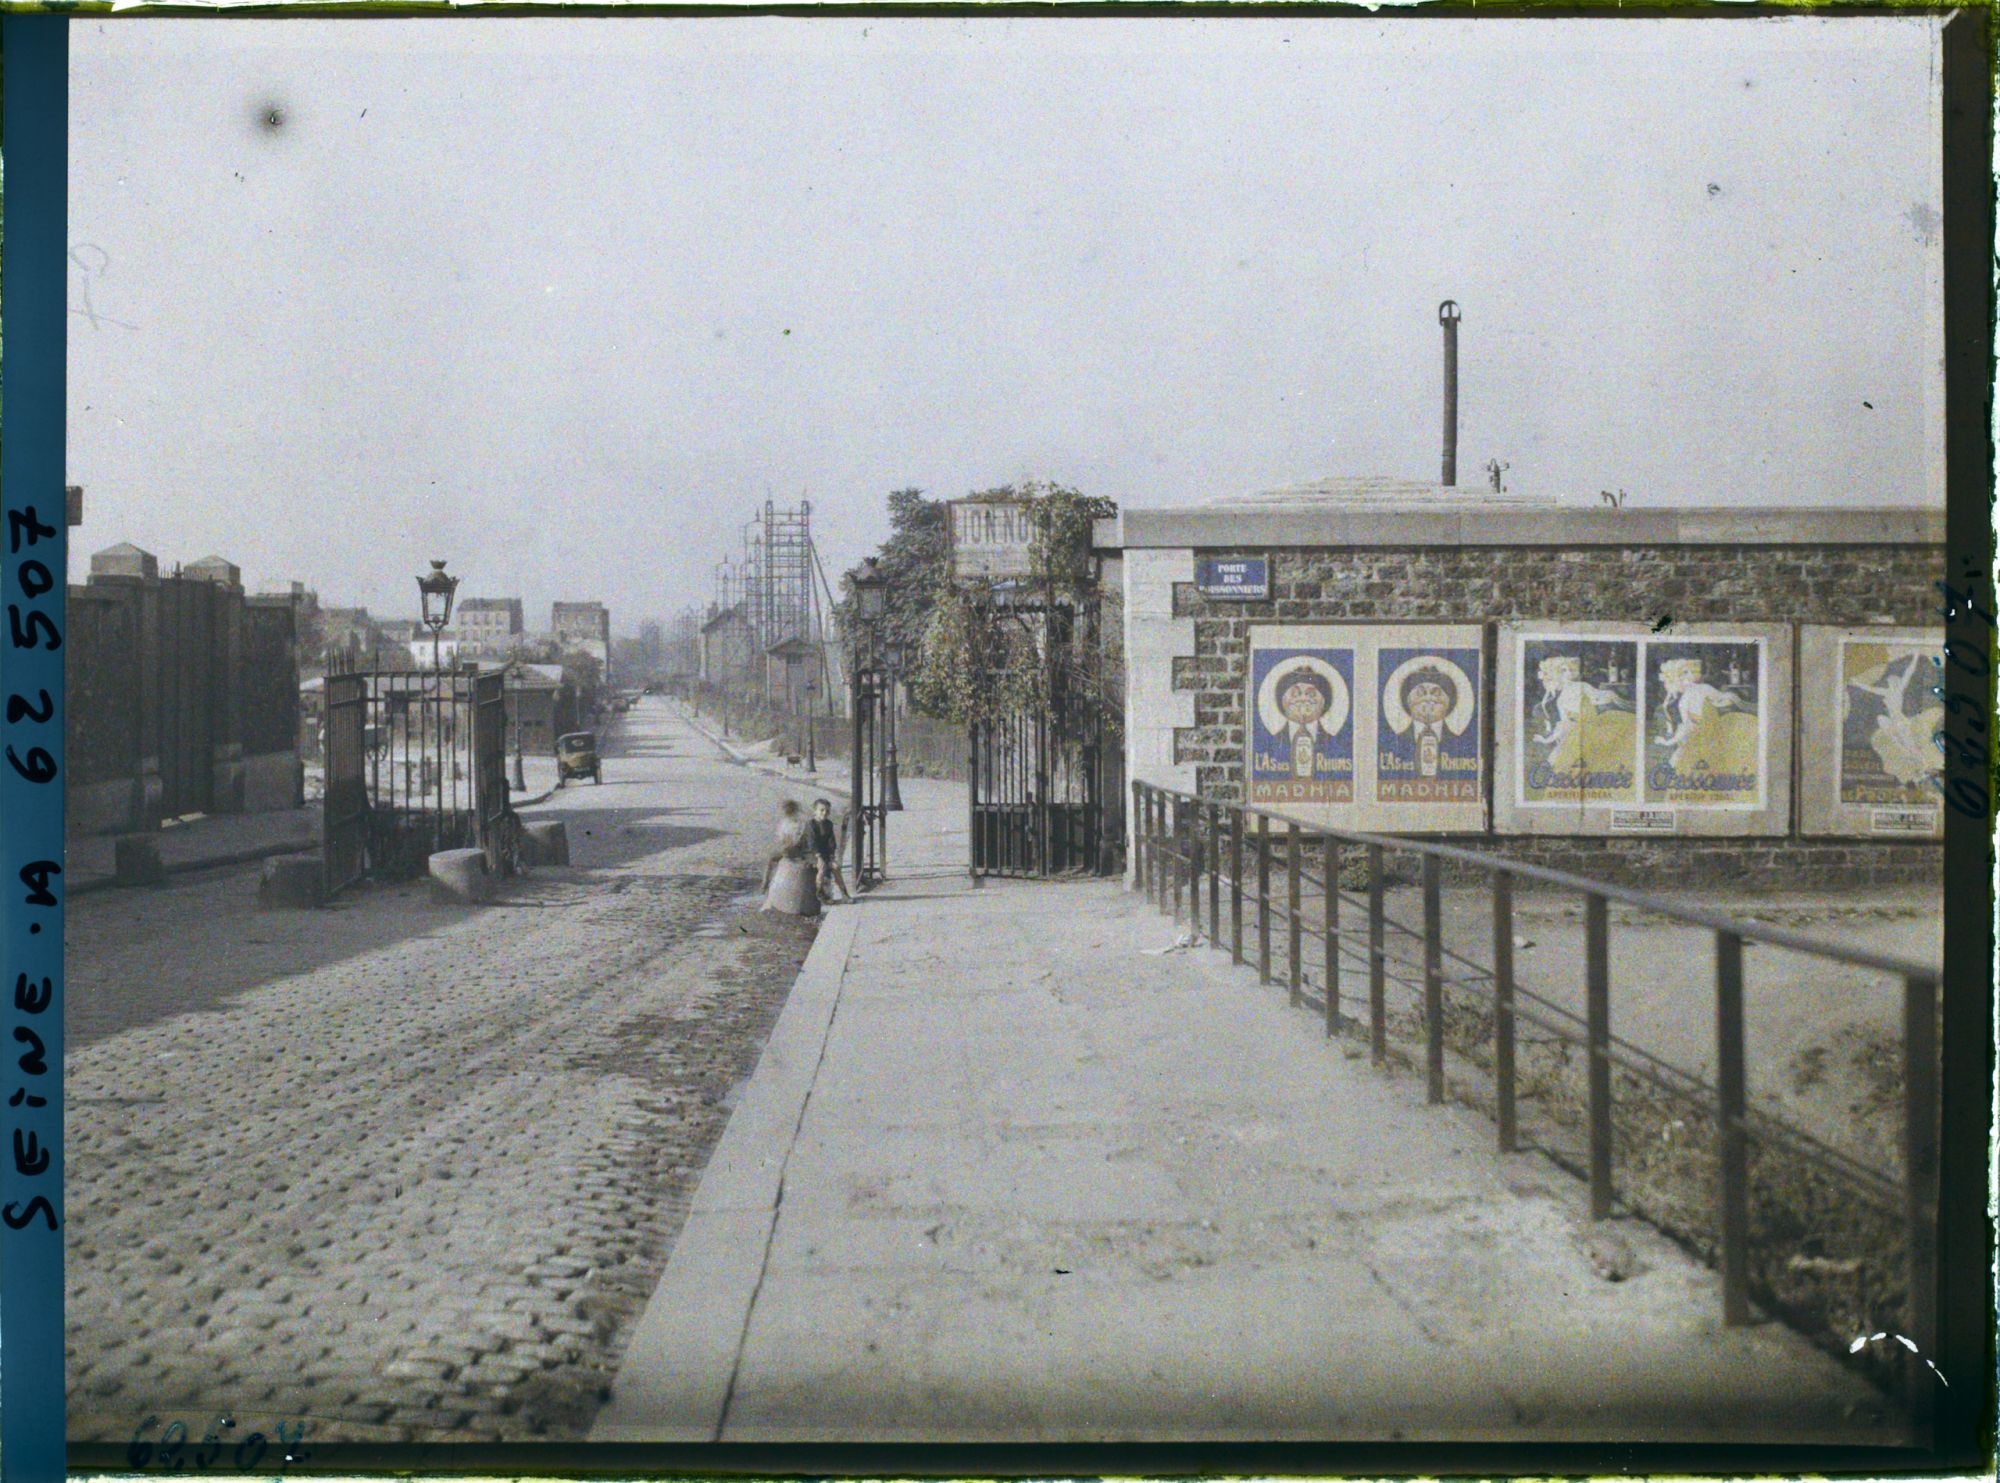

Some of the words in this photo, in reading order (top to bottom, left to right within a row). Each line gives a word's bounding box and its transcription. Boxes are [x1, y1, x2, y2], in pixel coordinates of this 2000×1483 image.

[1217, 564, 1247, 573] PORTE
[1223, 574, 1243, 584] DES
[1198, 585, 1266, 594] PISSONNIERS
